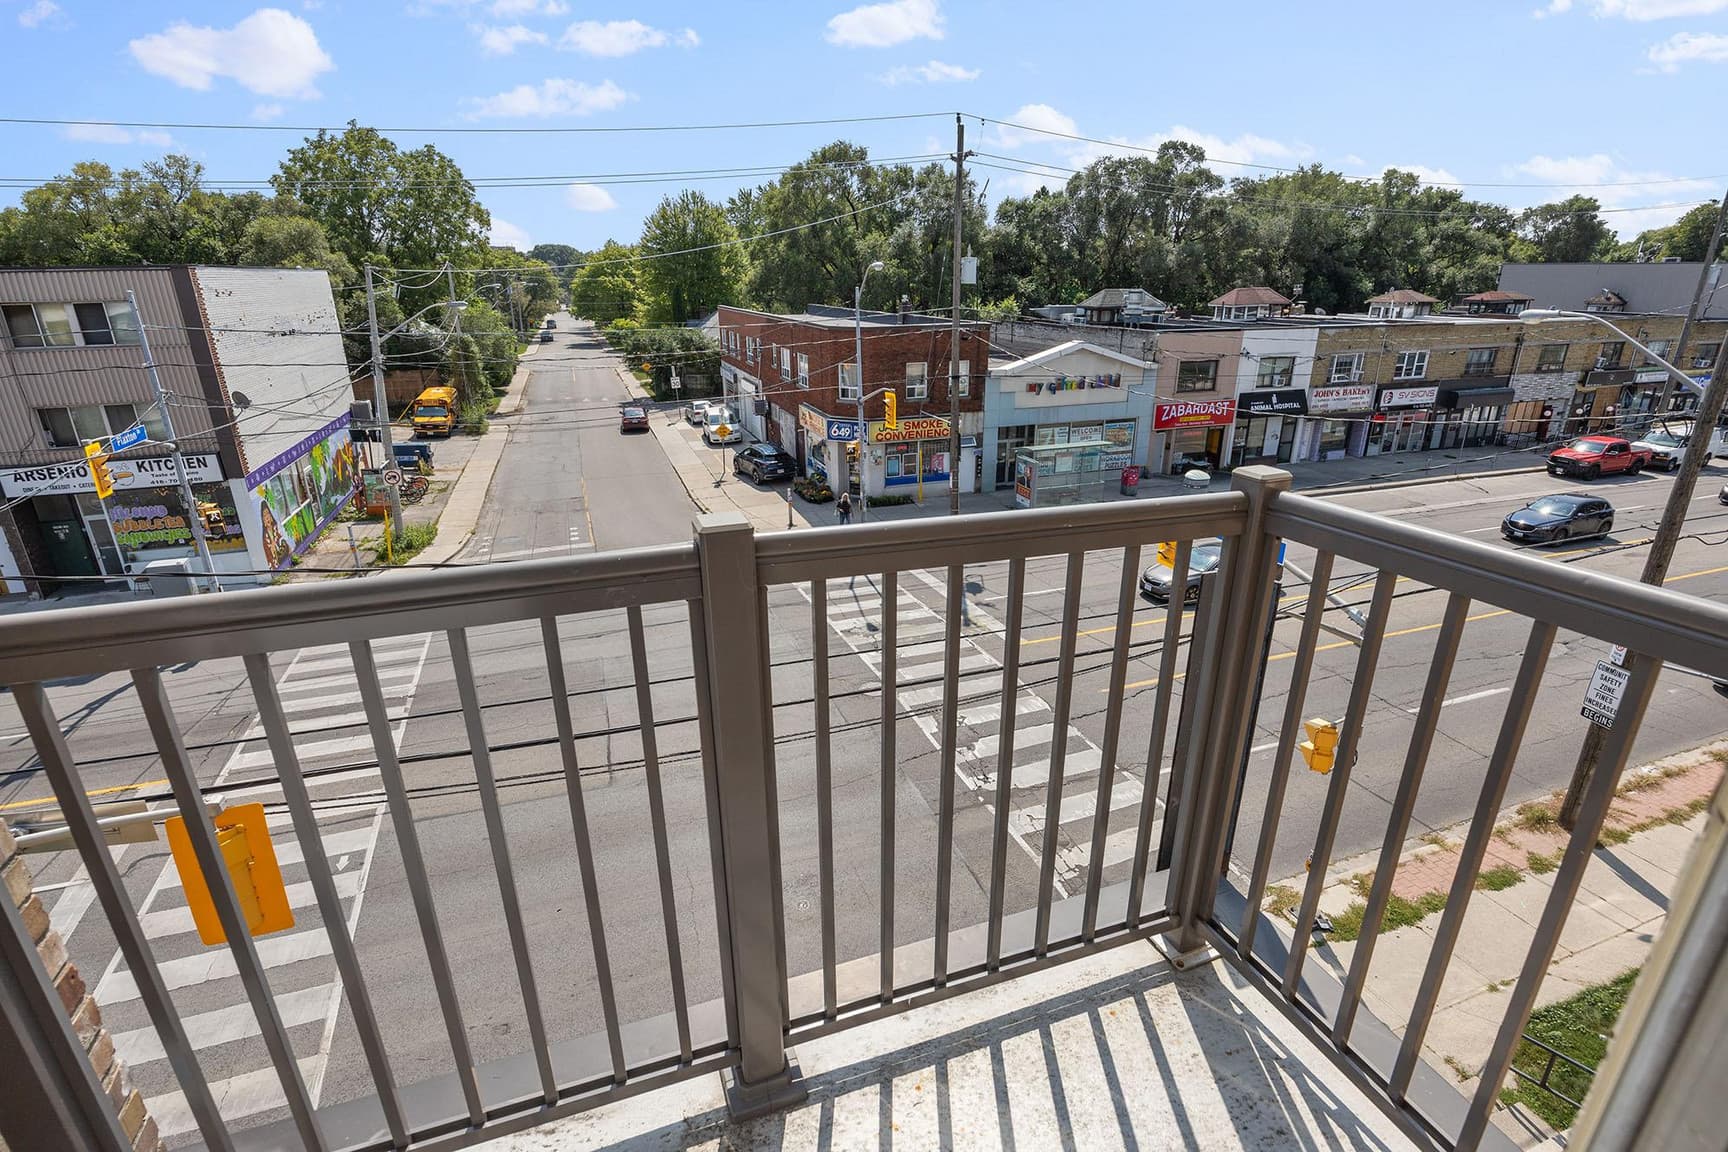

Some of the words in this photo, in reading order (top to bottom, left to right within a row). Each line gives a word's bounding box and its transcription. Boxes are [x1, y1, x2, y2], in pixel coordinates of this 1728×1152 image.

[1162, 401, 1229, 421] ZABARDAST
[1273, 402, 1301, 410] HOSPITAL
[904, 419, 944, 431] SMOKE
[875, 427, 951, 442] CONVENIENC
[1598, 663, 1628, 681] COMMUNIT
[1600, 673, 1622, 688] SAFETY
[1600, 683, 1616, 695] ZONE
[1595, 692, 1613, 704] FINES
[1583, 708, 1614, 728] BEGINS
